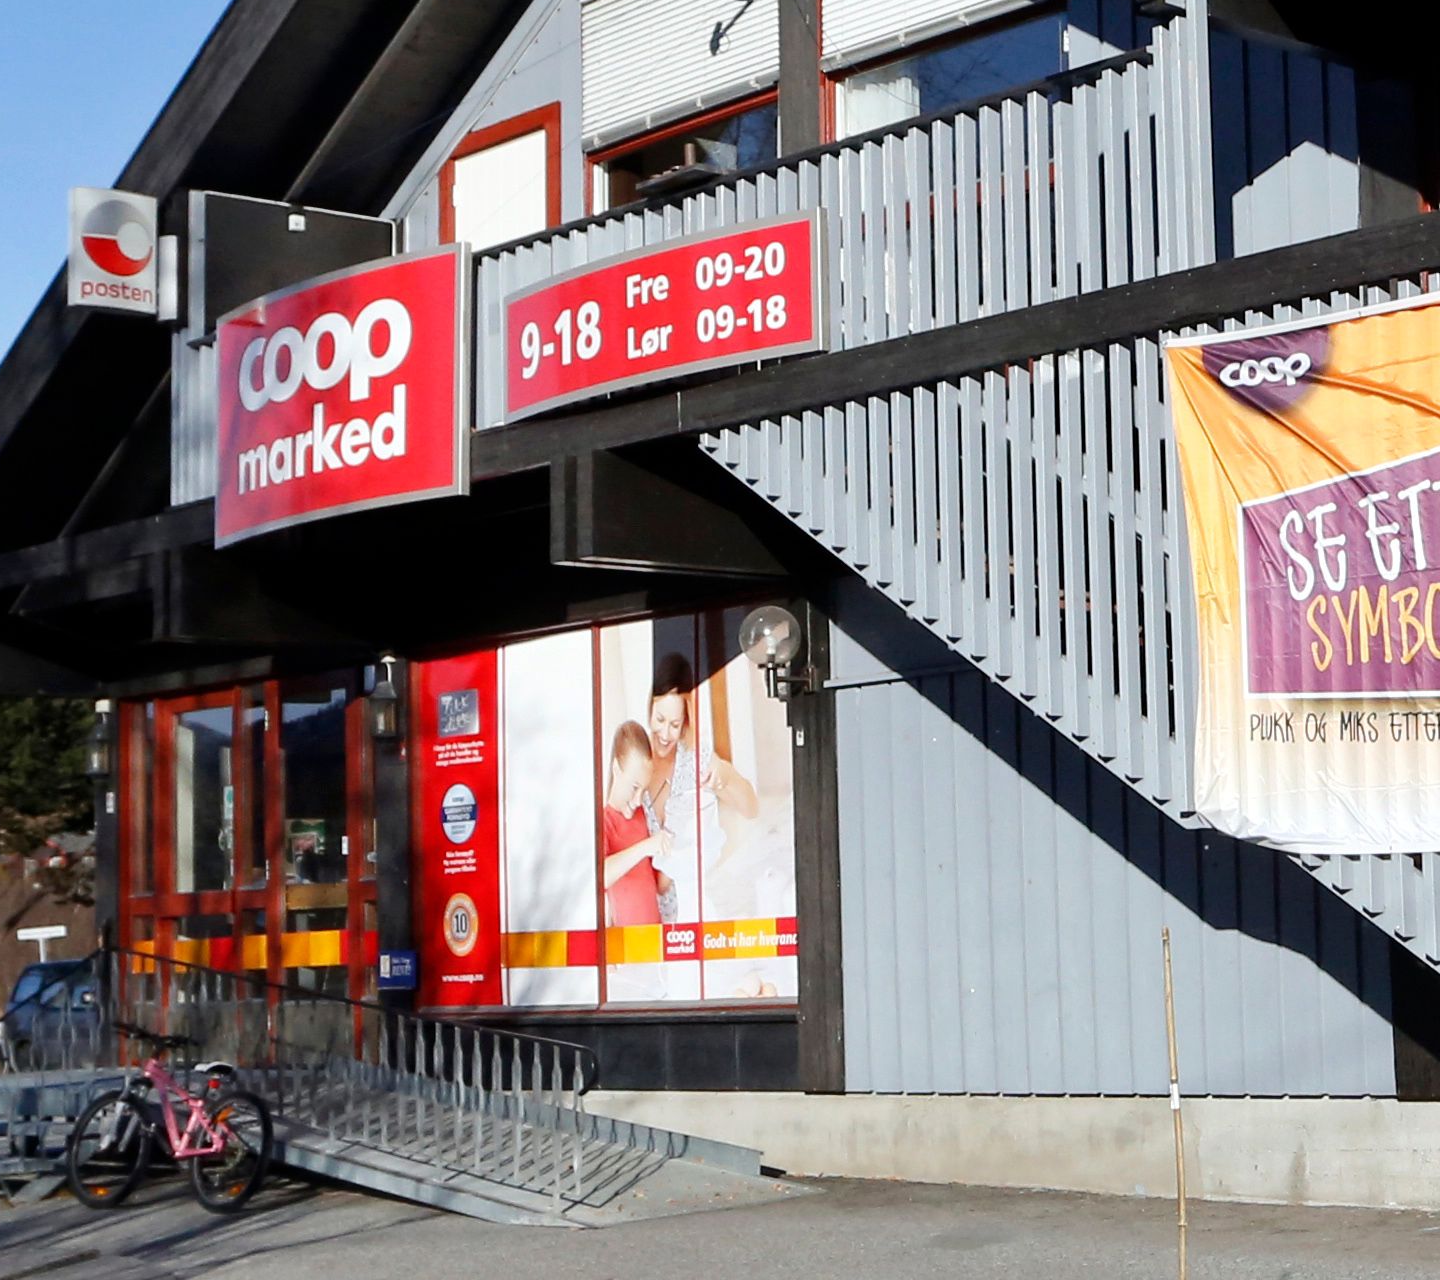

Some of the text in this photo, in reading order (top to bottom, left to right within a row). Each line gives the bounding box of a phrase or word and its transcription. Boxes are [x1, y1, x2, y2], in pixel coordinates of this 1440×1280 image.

[80, 280, 153, 305] posten
[625, 241, 786, 309] Fre 09-20
[520, 300, 603, 381] 9-18
[626, 294, 787, 361] Lør 09-18
[238, 297, 413, 412] coop
[1219, 352, 1311, 388] coop
[238, 383, 407, 496] marked
[1278, 501, 1347, 602] SE
[1249, 711, 1296, 743] PLUKK
[1304, 712, 1328, 743] OG
[1339, 710, 1380, 743] MIKS
[453, 912, 468, 934] 10
[666, 929, 696, 945] coop
[703, 933, 727, 950] Godt
[728, 931, 737, 948] vi
[739, 931, 757, 948] har
[666, 942, 696, 955] marked
